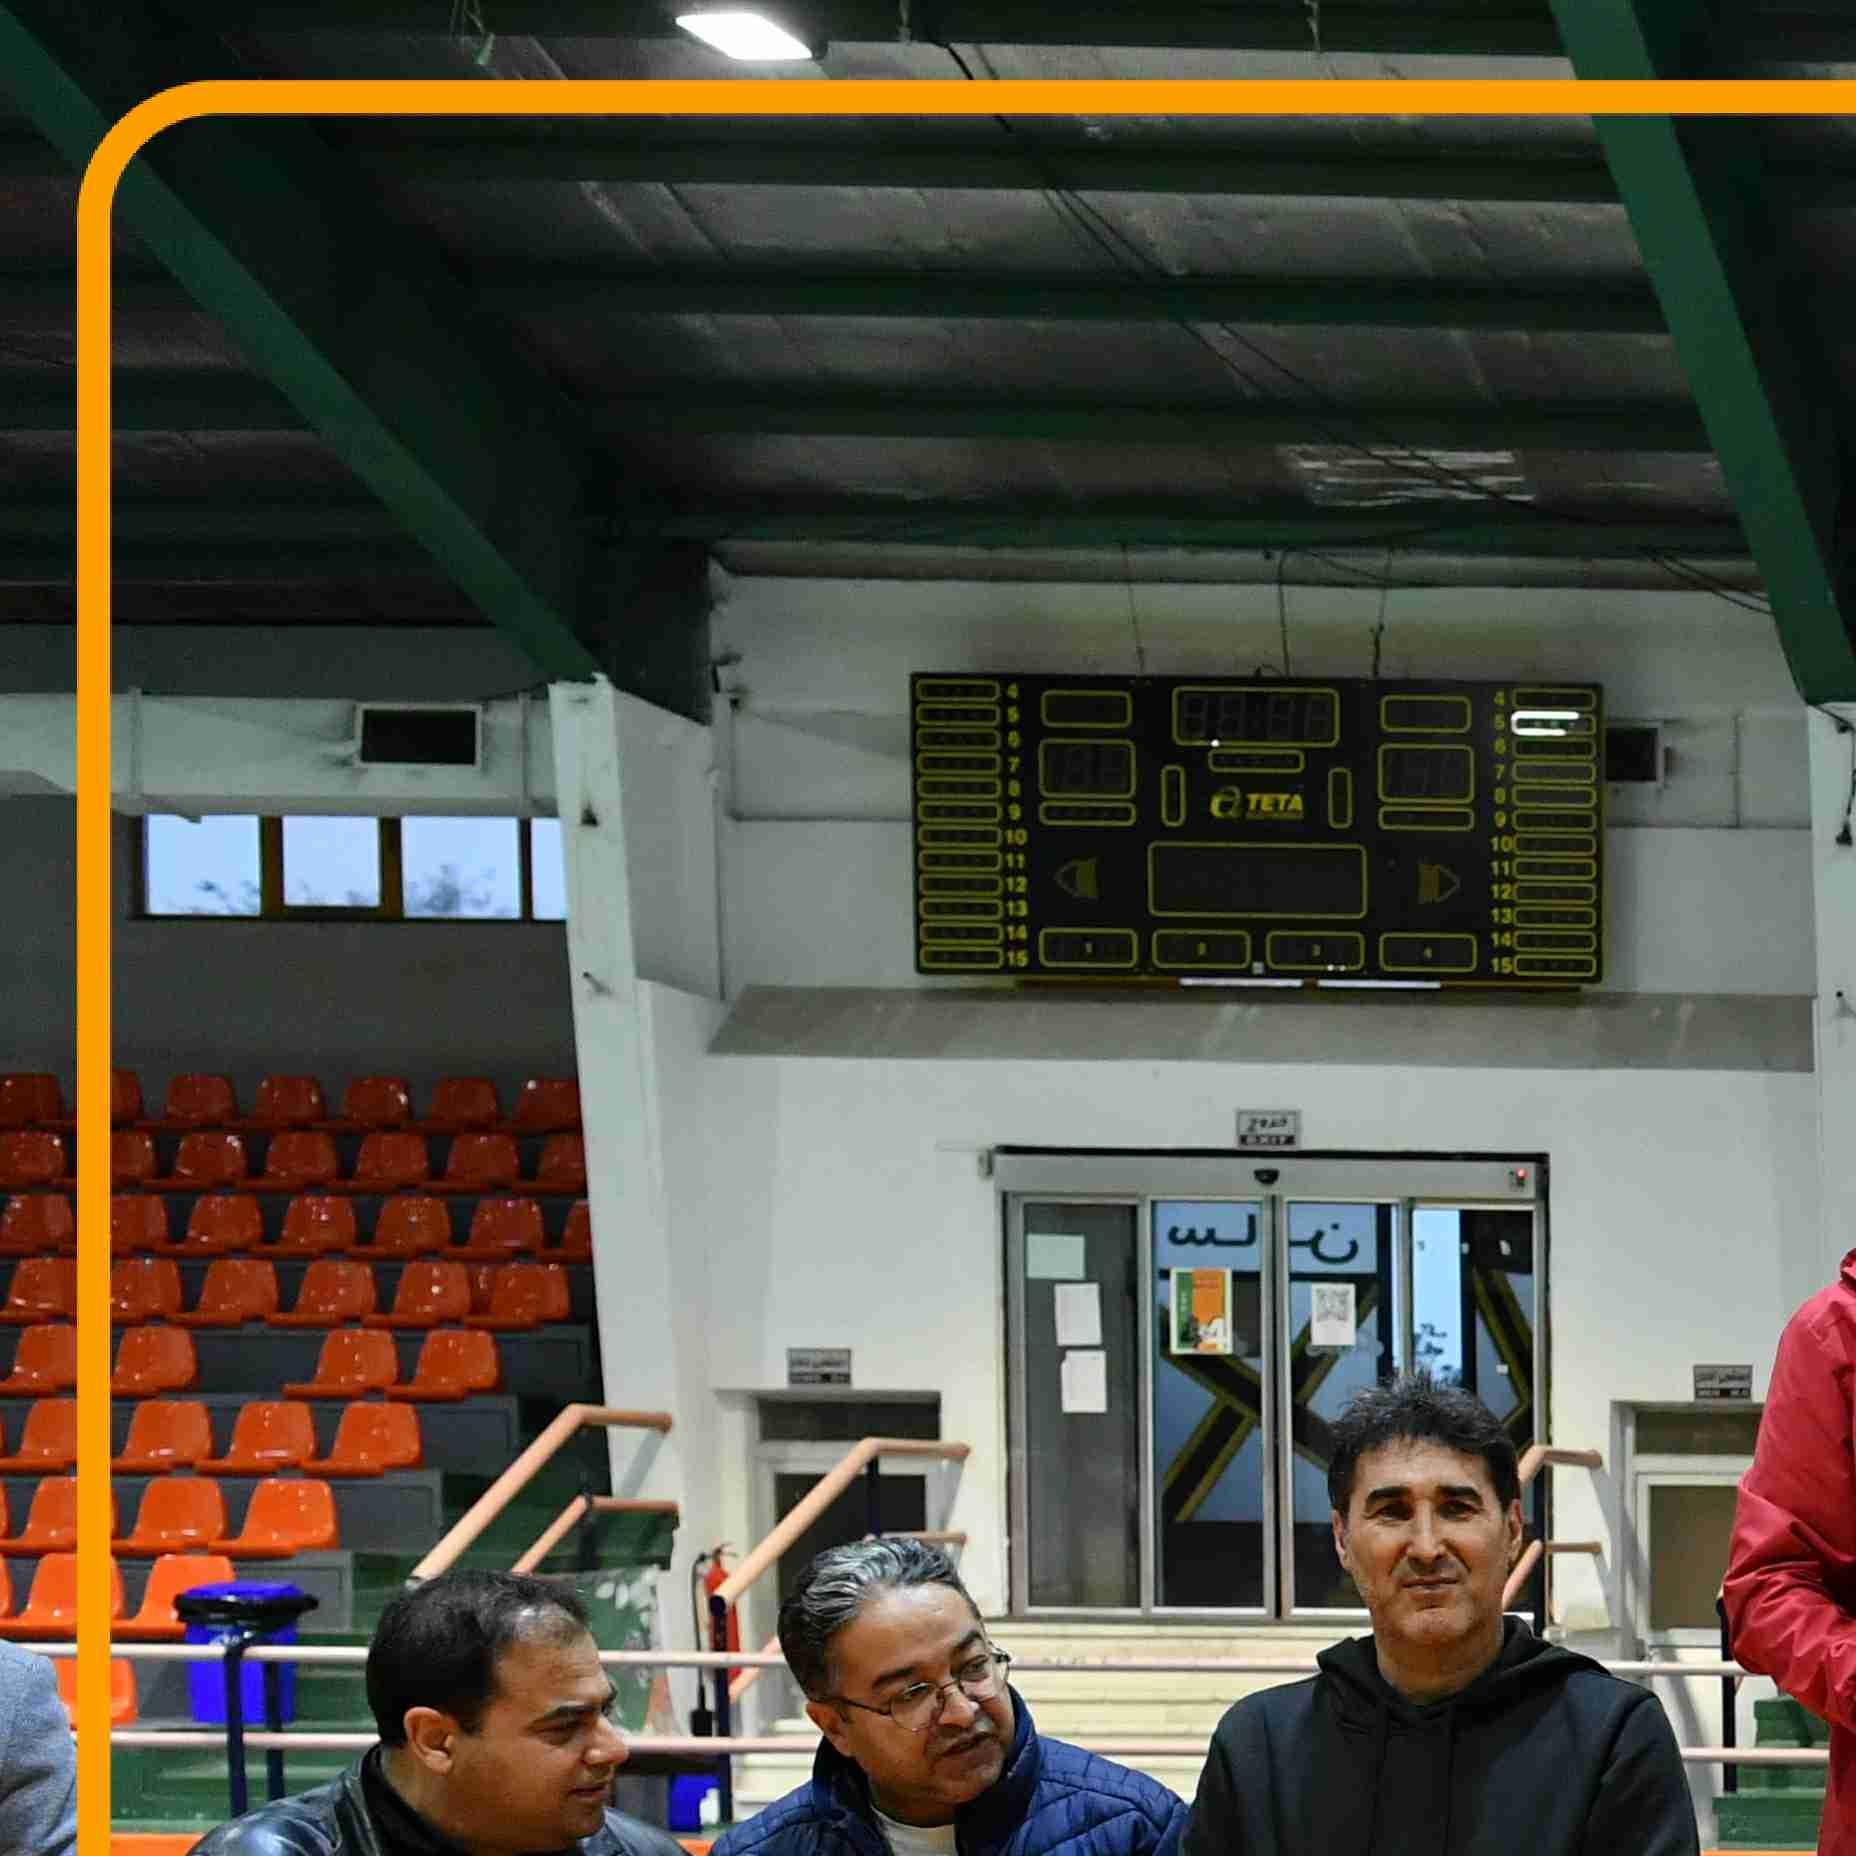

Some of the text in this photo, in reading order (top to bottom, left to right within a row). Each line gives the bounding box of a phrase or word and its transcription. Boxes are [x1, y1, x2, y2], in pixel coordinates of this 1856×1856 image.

[1007, 756, 1020, 773] 7
[1493, 763, 1505, 780] 7
[1247, 792, 1303, 812] TETA
[1007, 829, 1028, 846] 10
[1490, 836, 1512, 852] 10
[1006, 853, 1025, 869] 11
[1490, 860, 1509, 876] 11
[1006, 876, 1027, 893] 12
[1490, 883, 1512, 899] 12
[1006, 899, 1028, 917] 13
[1491, 907, 1512, 923] 13
[1007, 923, 1028, 940] 14
[1491, 931, 1512, 947] 14
[1007, 949, 1028, 967] 15
[1490, 957, 1513, 974] 15
